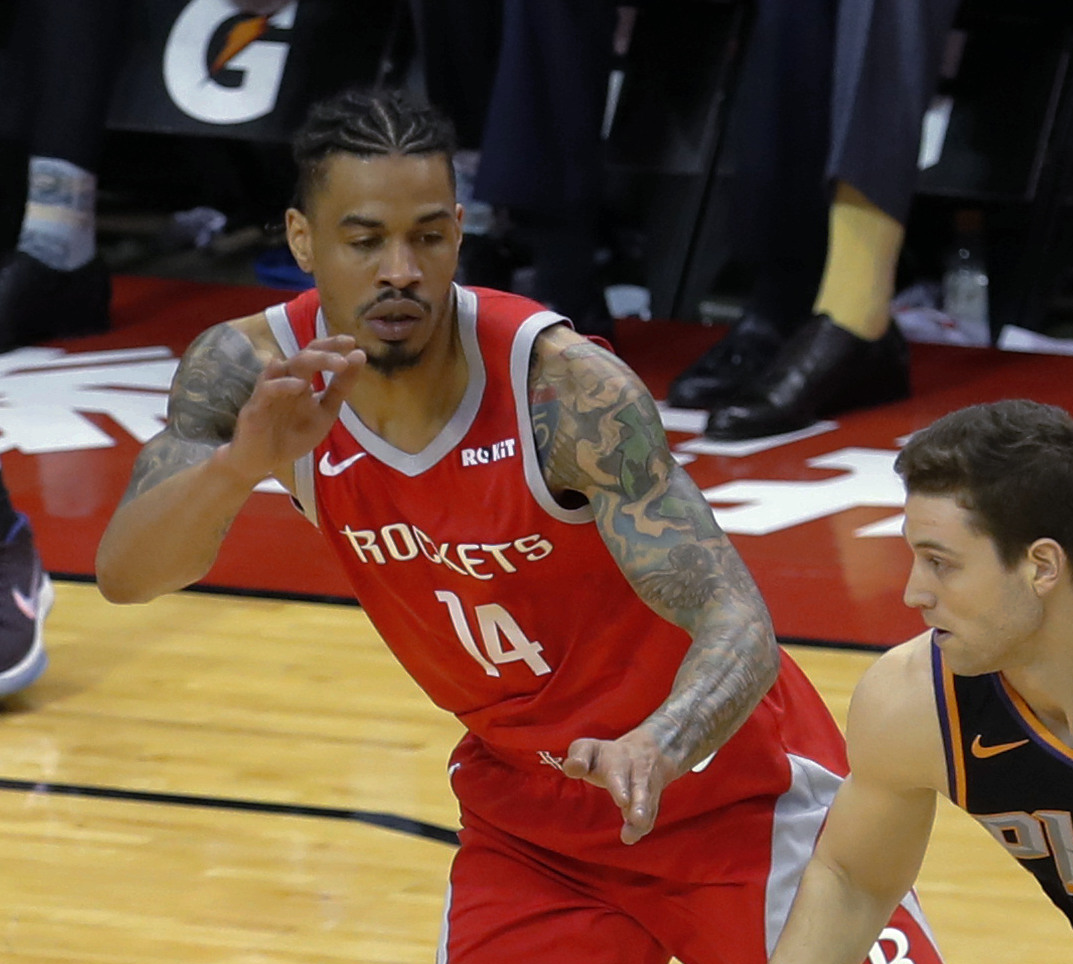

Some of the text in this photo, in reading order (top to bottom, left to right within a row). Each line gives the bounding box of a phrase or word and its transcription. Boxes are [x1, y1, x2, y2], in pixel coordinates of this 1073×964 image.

[163, 0, 297, 124] G
[339, 523, 554, 580] ROCKETS
[434, 589, 553, 678] 14
